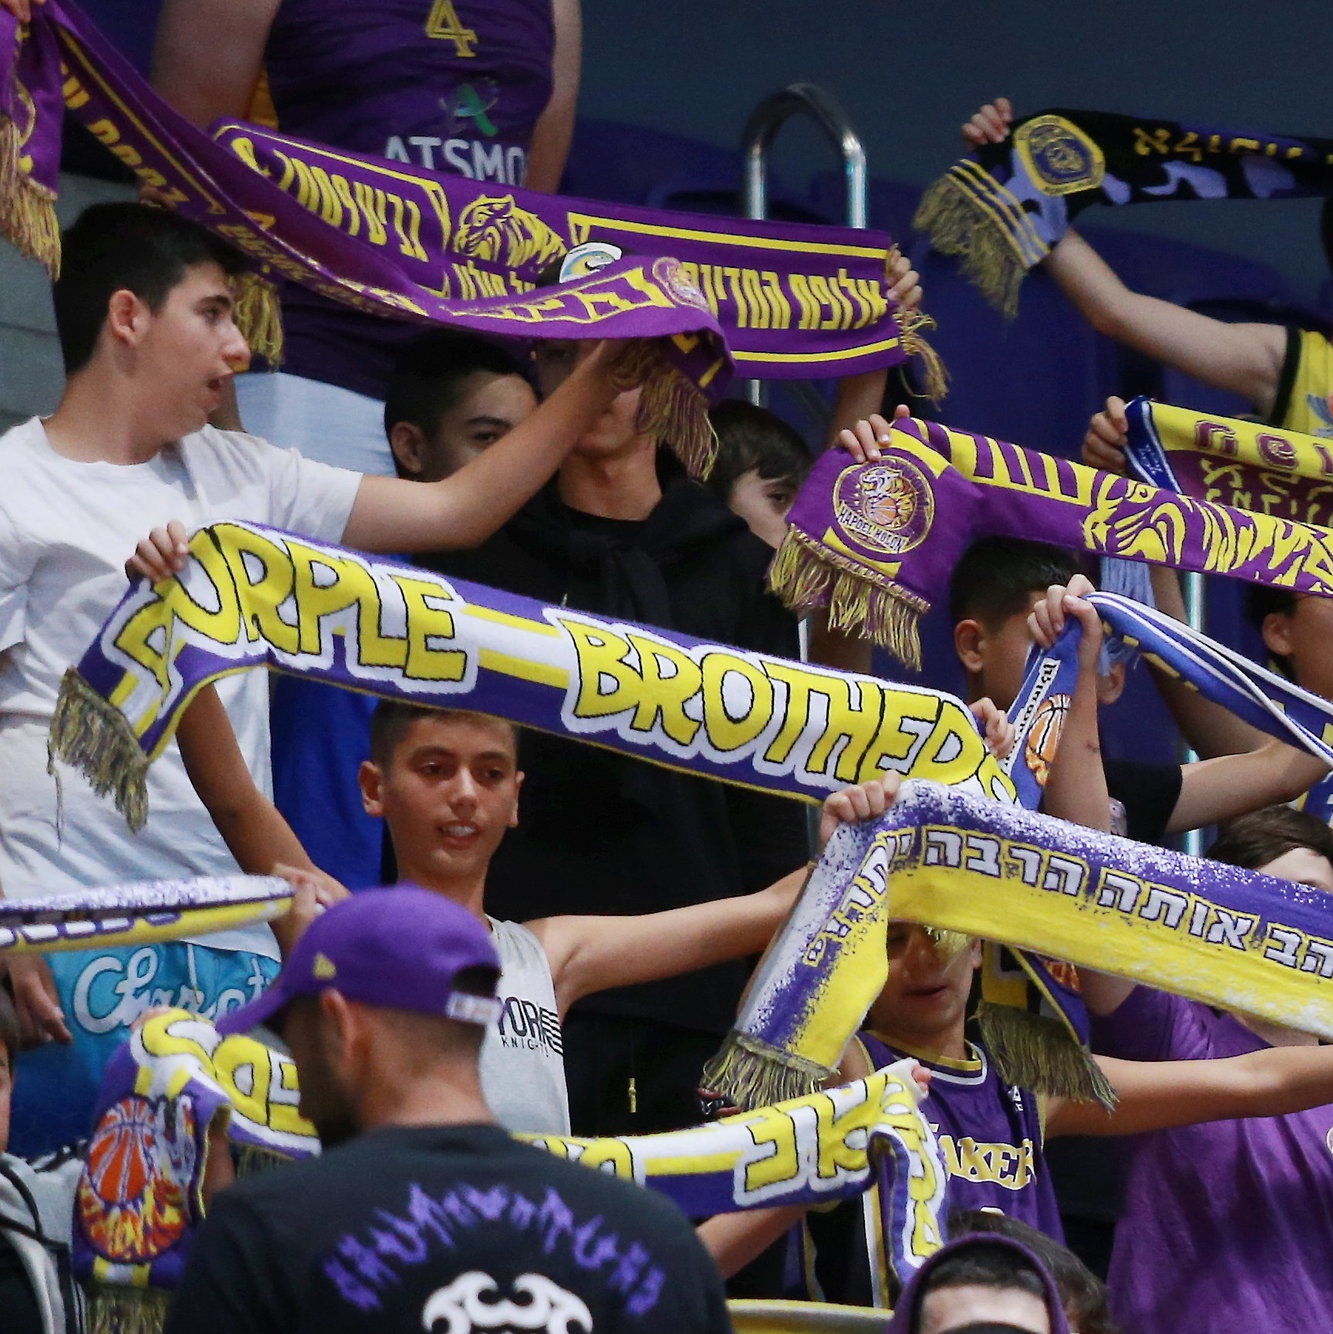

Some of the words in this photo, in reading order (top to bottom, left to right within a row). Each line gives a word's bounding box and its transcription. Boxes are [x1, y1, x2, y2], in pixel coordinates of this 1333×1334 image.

[797, 267, 888, 332] אלופת
[924, 828, 1087, 896] הרבה
[1096, 871, 1254, 951] אותה
